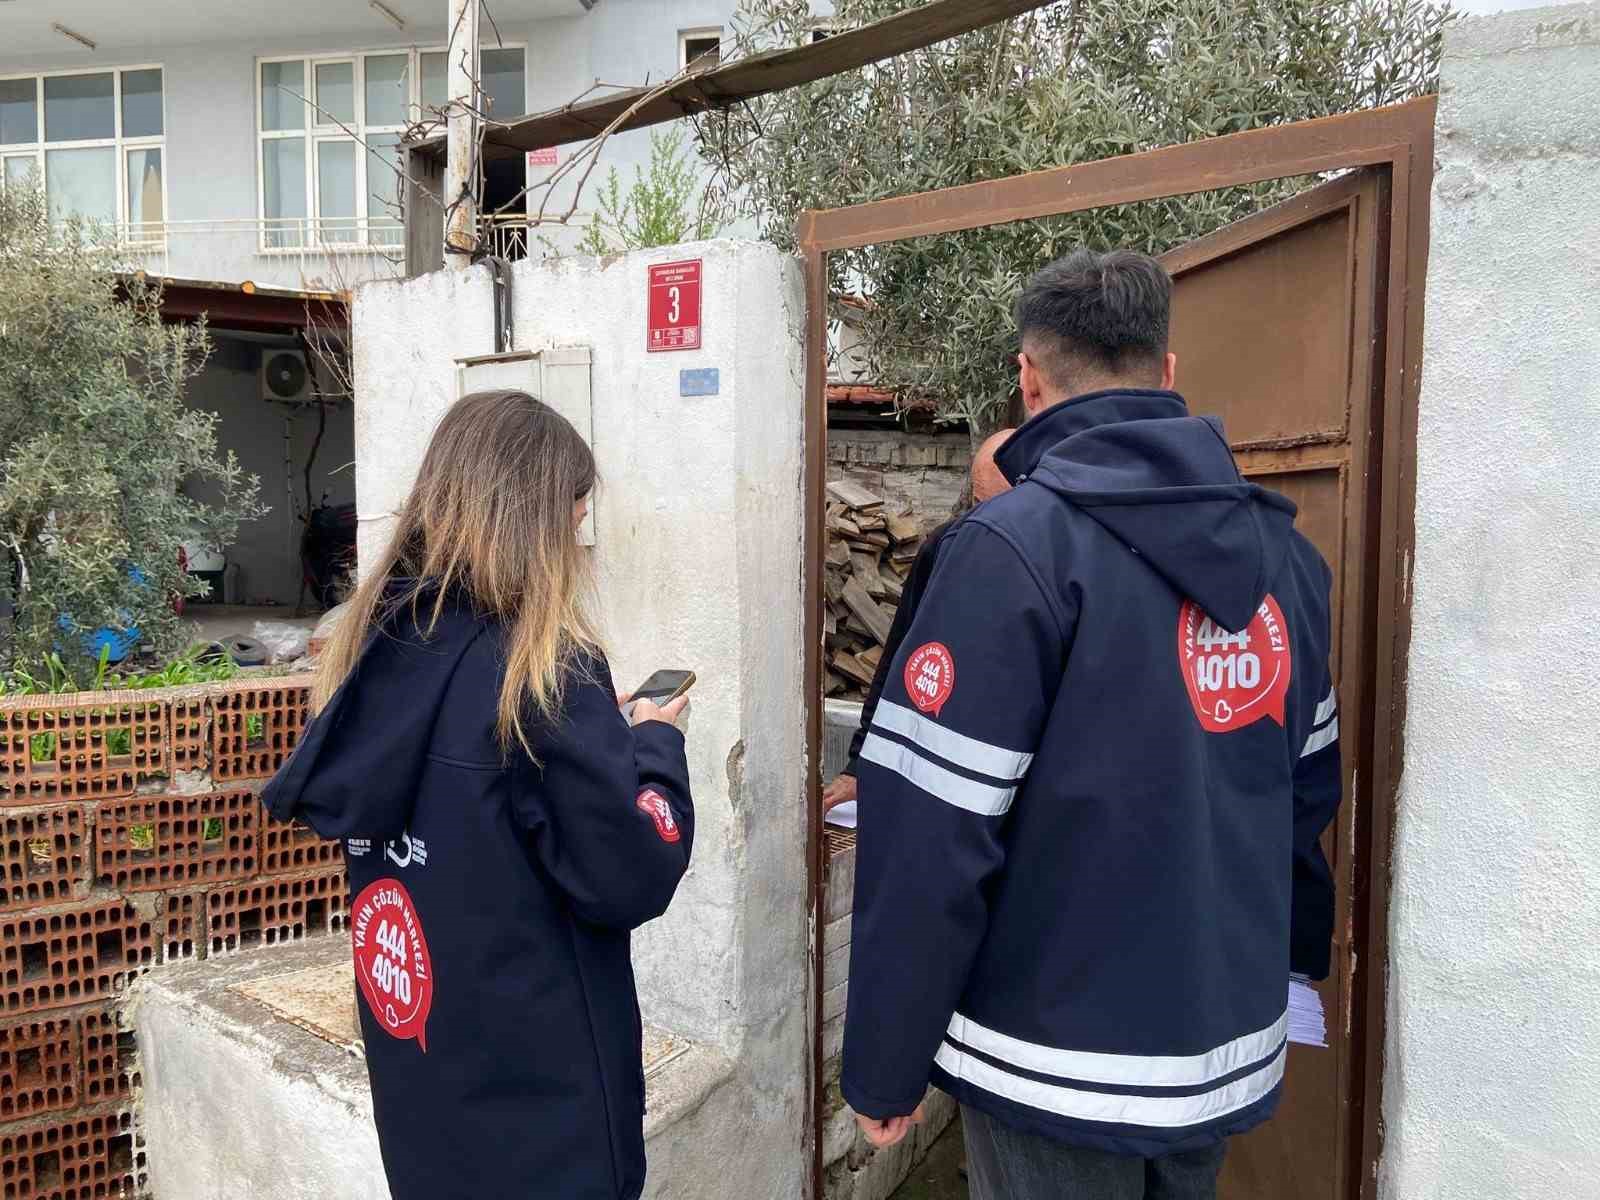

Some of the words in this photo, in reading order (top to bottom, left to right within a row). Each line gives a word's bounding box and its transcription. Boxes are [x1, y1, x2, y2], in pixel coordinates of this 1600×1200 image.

[668, 286, 680, 324] 3
[1257, 602, 1286, 651] RKEZİ
[915, 674, 939, 698] 4010
[921, 660, 941, 681] 444
[354, 903, 375, 948] YAKIN
[372, 887, 404, 912] ÇÖZÜM
[375, 919, 407, 966] 444
[371, 953, 412, 1007] 4010
